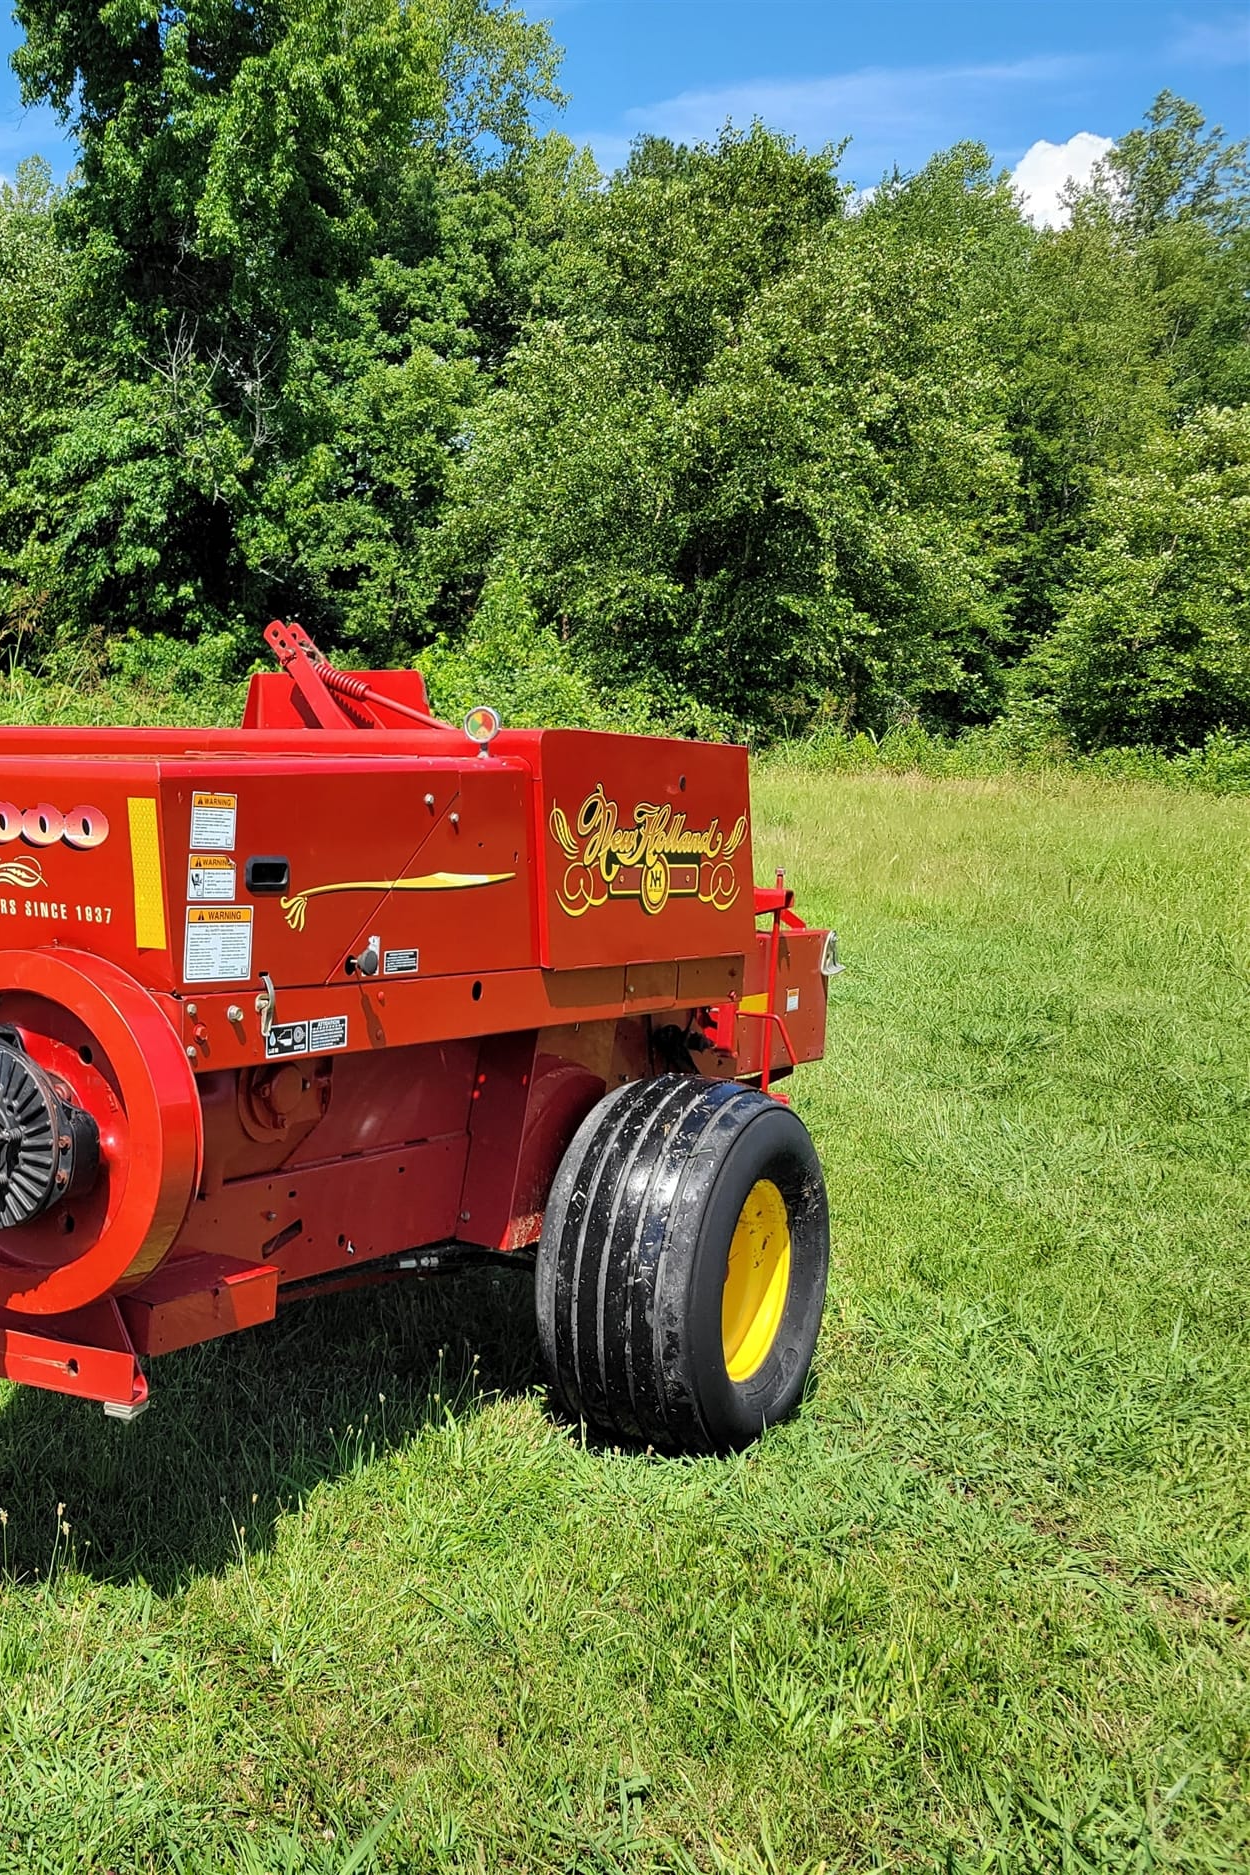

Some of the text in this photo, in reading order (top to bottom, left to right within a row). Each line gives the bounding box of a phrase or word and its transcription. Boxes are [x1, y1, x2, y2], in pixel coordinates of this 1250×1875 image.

[204, 797, 232, 807] WARNING
[577, 783, 723, 882] New Holland
[650, 870, 662, 888] NH
[25, 900, 67, 920] SINCE
[75, 905, 111, 924] 1937
[208, 910, 242, 920] WARNING
